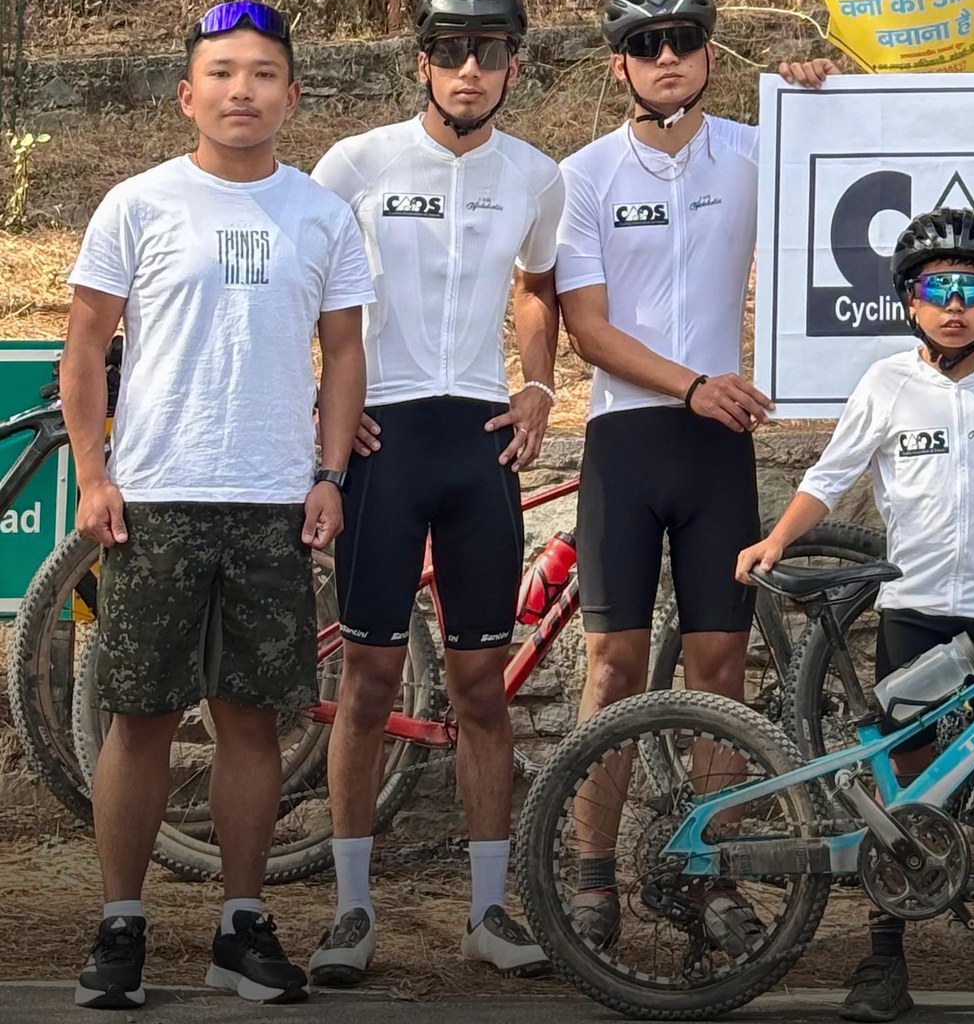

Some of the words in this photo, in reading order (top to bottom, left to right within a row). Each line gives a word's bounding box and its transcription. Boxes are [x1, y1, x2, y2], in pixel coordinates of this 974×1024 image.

[875, 20, 950, 48] बचाना
[835, 295, 905, 327] Cyclin
[0, 501, 41, 534] ad
